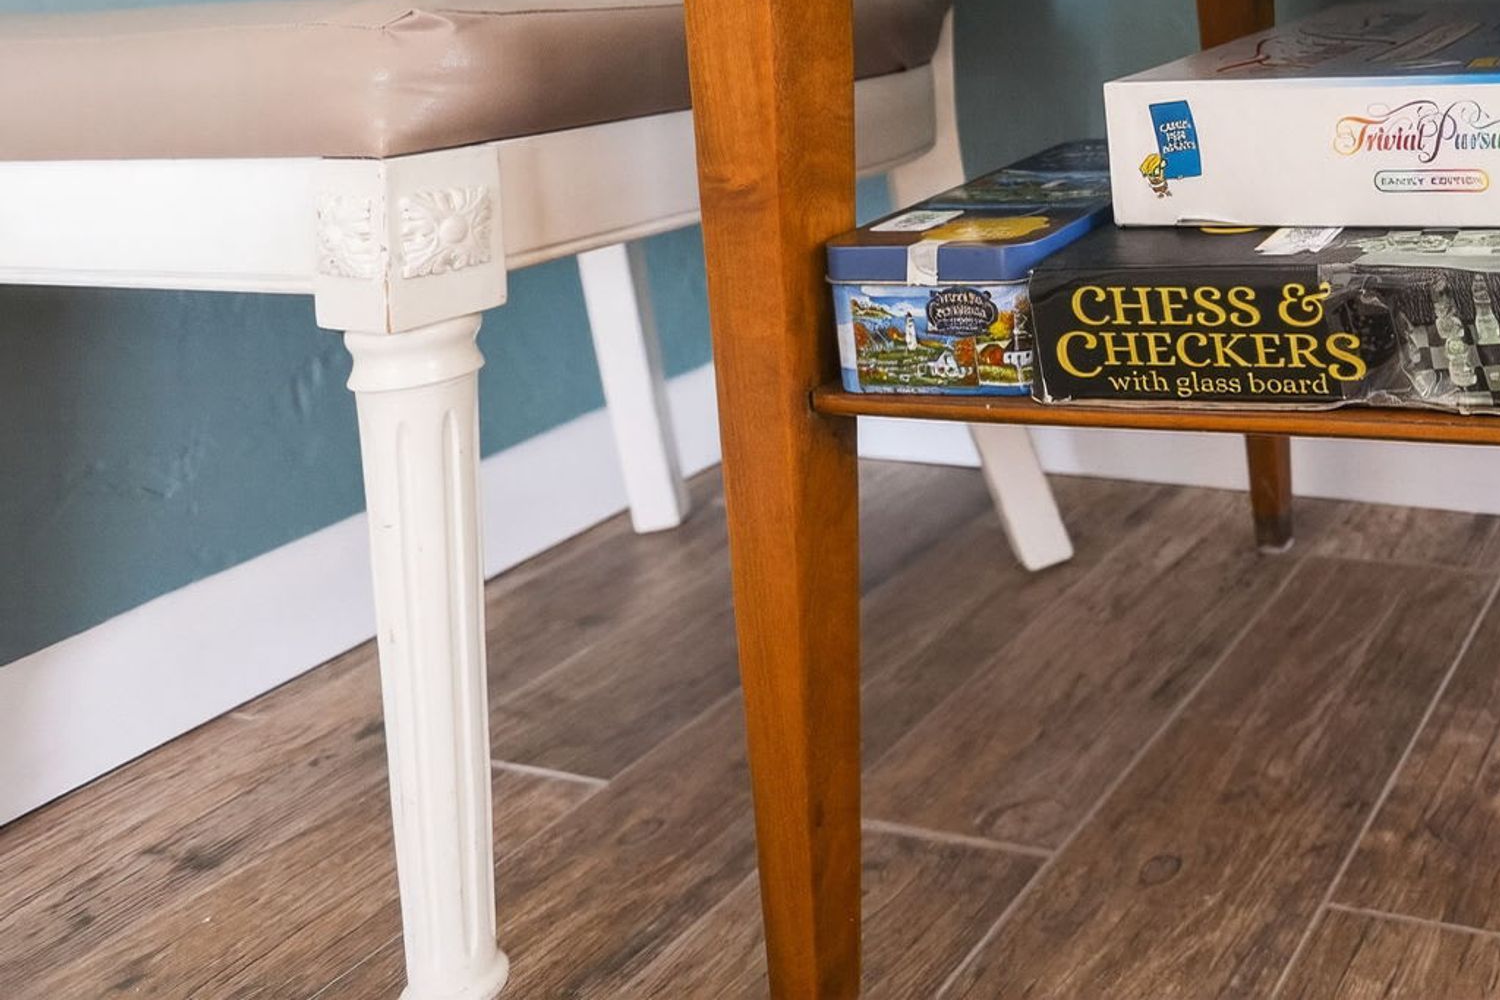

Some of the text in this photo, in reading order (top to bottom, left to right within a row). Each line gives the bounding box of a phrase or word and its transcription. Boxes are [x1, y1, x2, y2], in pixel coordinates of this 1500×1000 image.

[1334, 101, 1430, 156] Trivial
[1381, 175, 1483, 186] FAMILY EDITION
[1071, 282, 1332, 328] CHESS &
[1056, 330, 1367, 381] CHECKERS
[1108, 371, 1330, 398] with glass board
